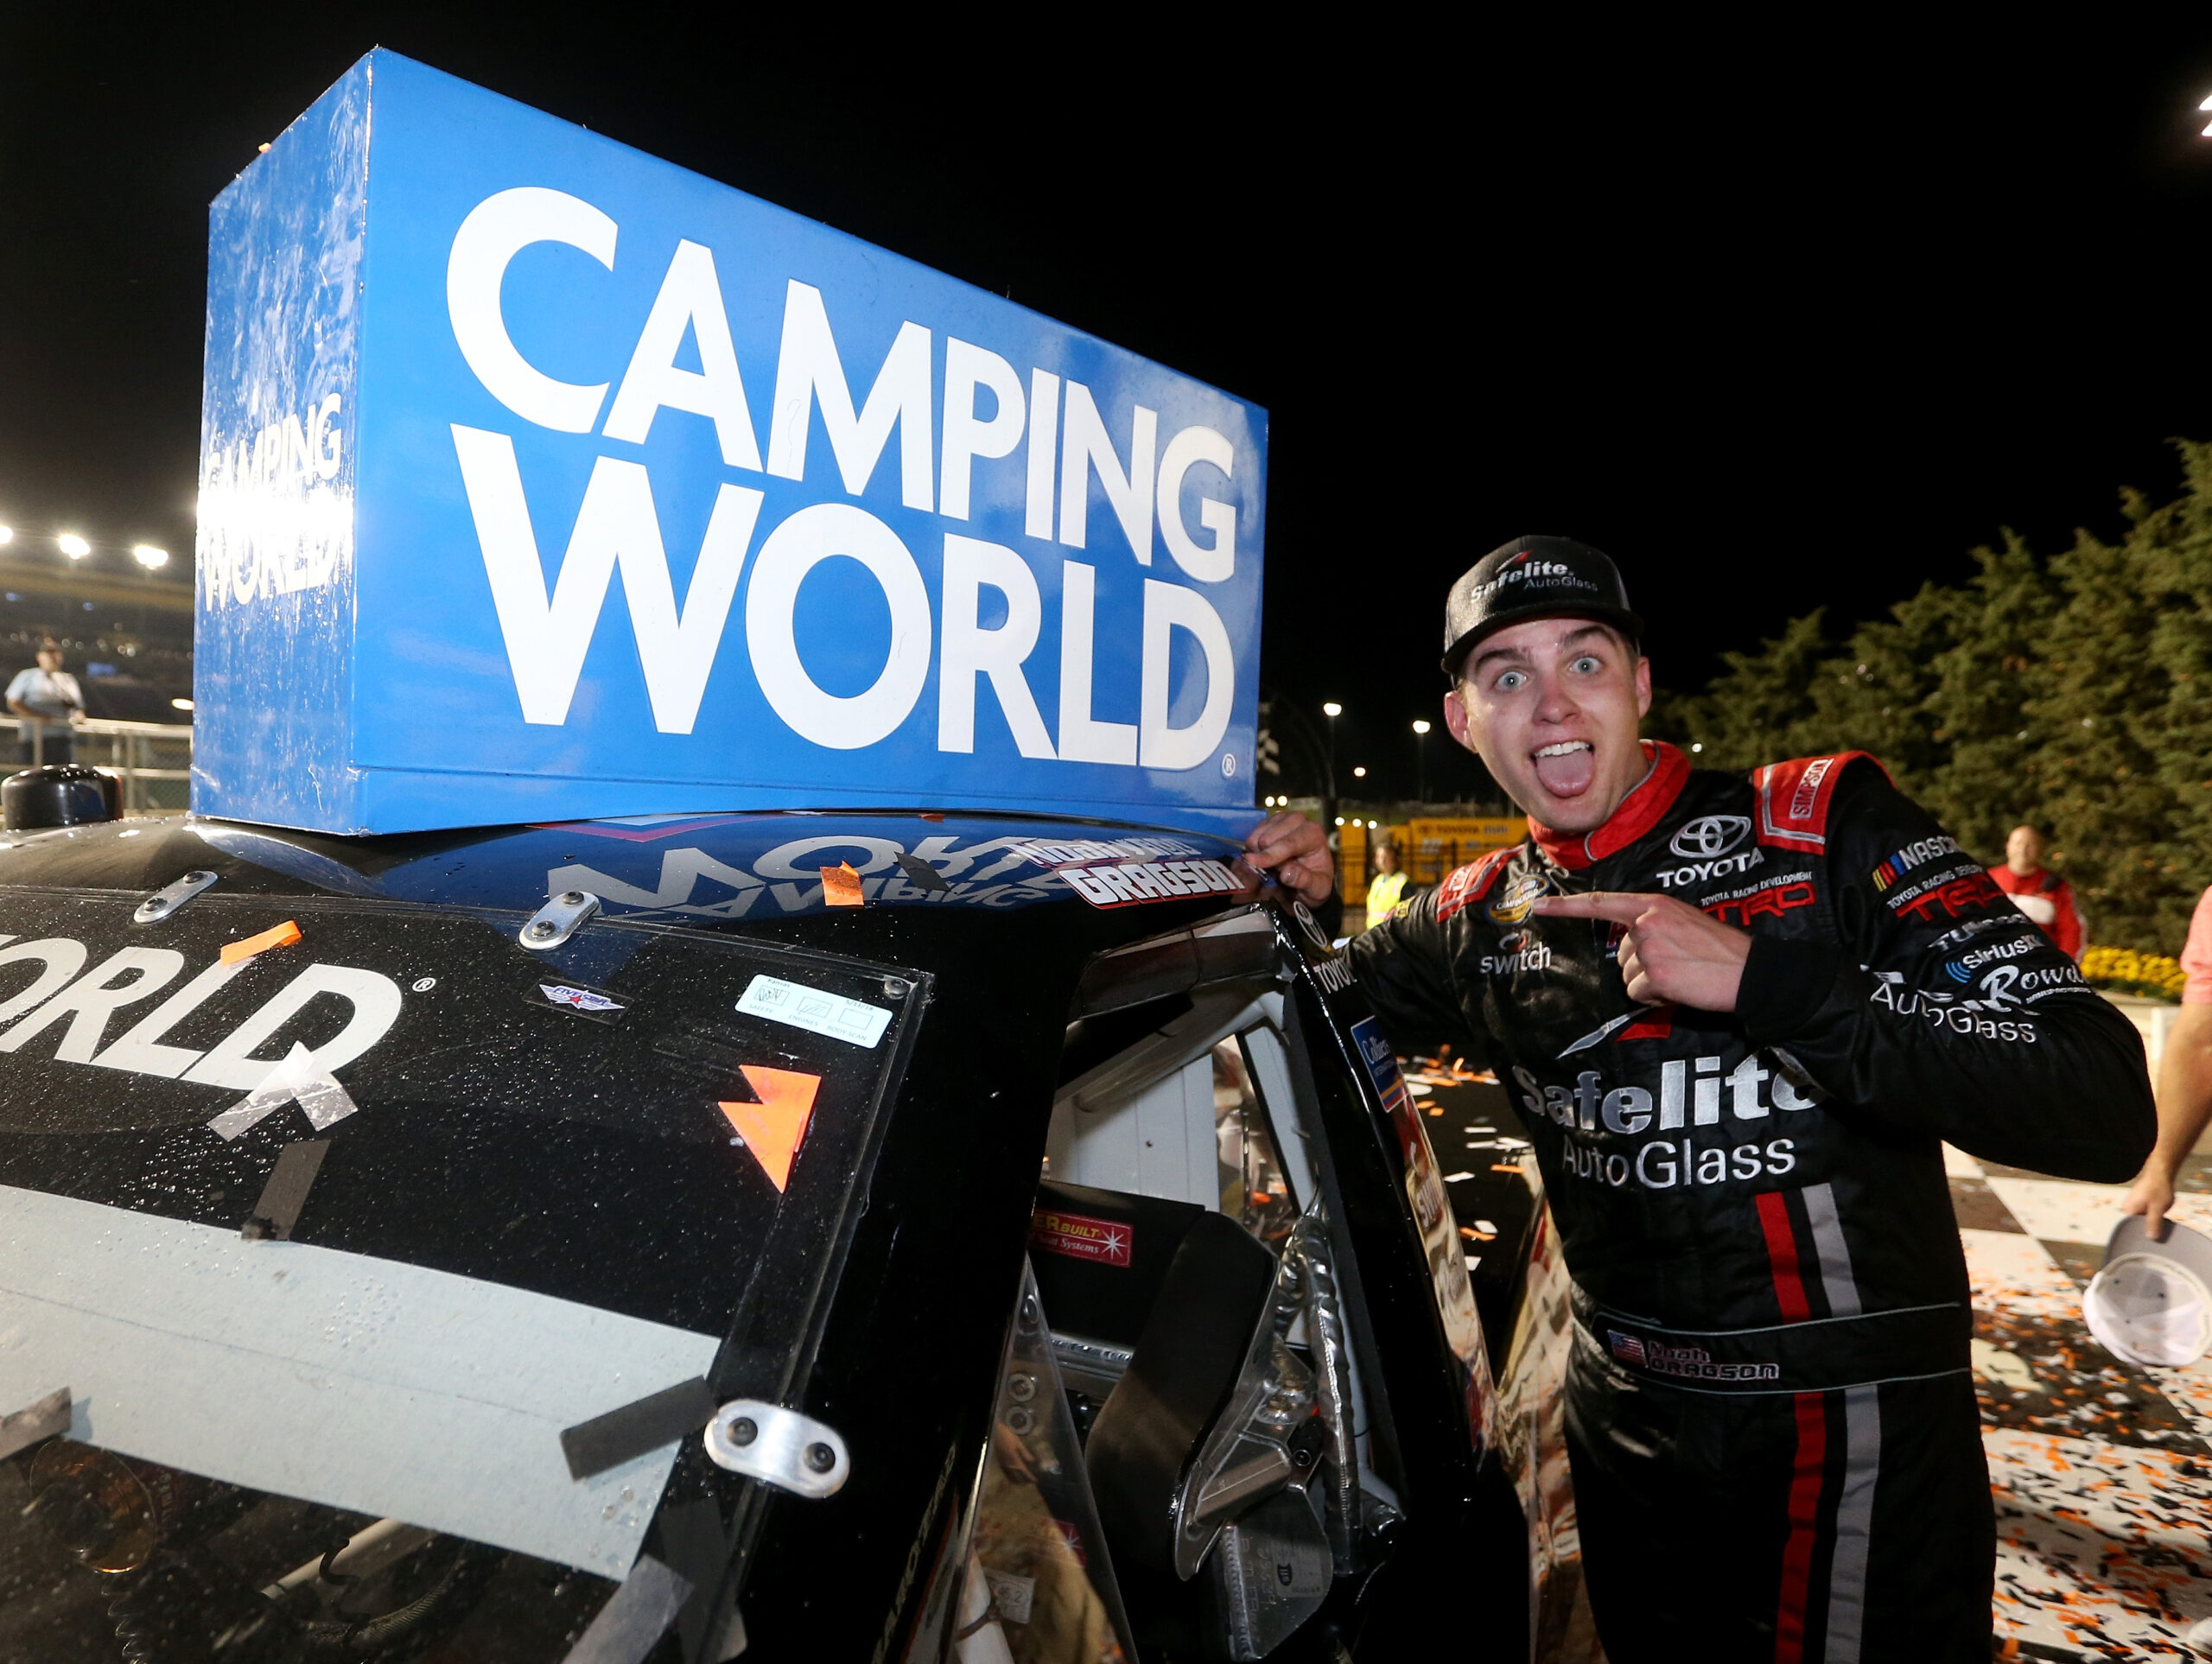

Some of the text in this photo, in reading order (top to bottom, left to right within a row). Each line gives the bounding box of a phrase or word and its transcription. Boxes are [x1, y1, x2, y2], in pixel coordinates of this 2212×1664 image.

[447, 187, 1236, 583] CAMPING
[449, 422, 1235, 771] WORLD
[1523, 576, 1599, 593] AutoGlass
[1656, 847, 1764, 888] TOYOTA
[1700, 871, 1812, 906] TOYOTA RACING DEVELOPMENT
[1702, 881, 1816, 926] TRD
[1886, 886, 1923, 909] TOYOTA
[1922, 870, 1956, 890] RACING
[1479, 942, 1552, 975] switch
[1979, 964, 2089, 1013] Rowd
[0, 935, 402, 1091] ORLD
[1562, 1137, 1797, 1190] AutoGlass
[1060, 1236, 1099, 1254] Systems
[1649, 1357, 1780, 1381] GRAGSON
